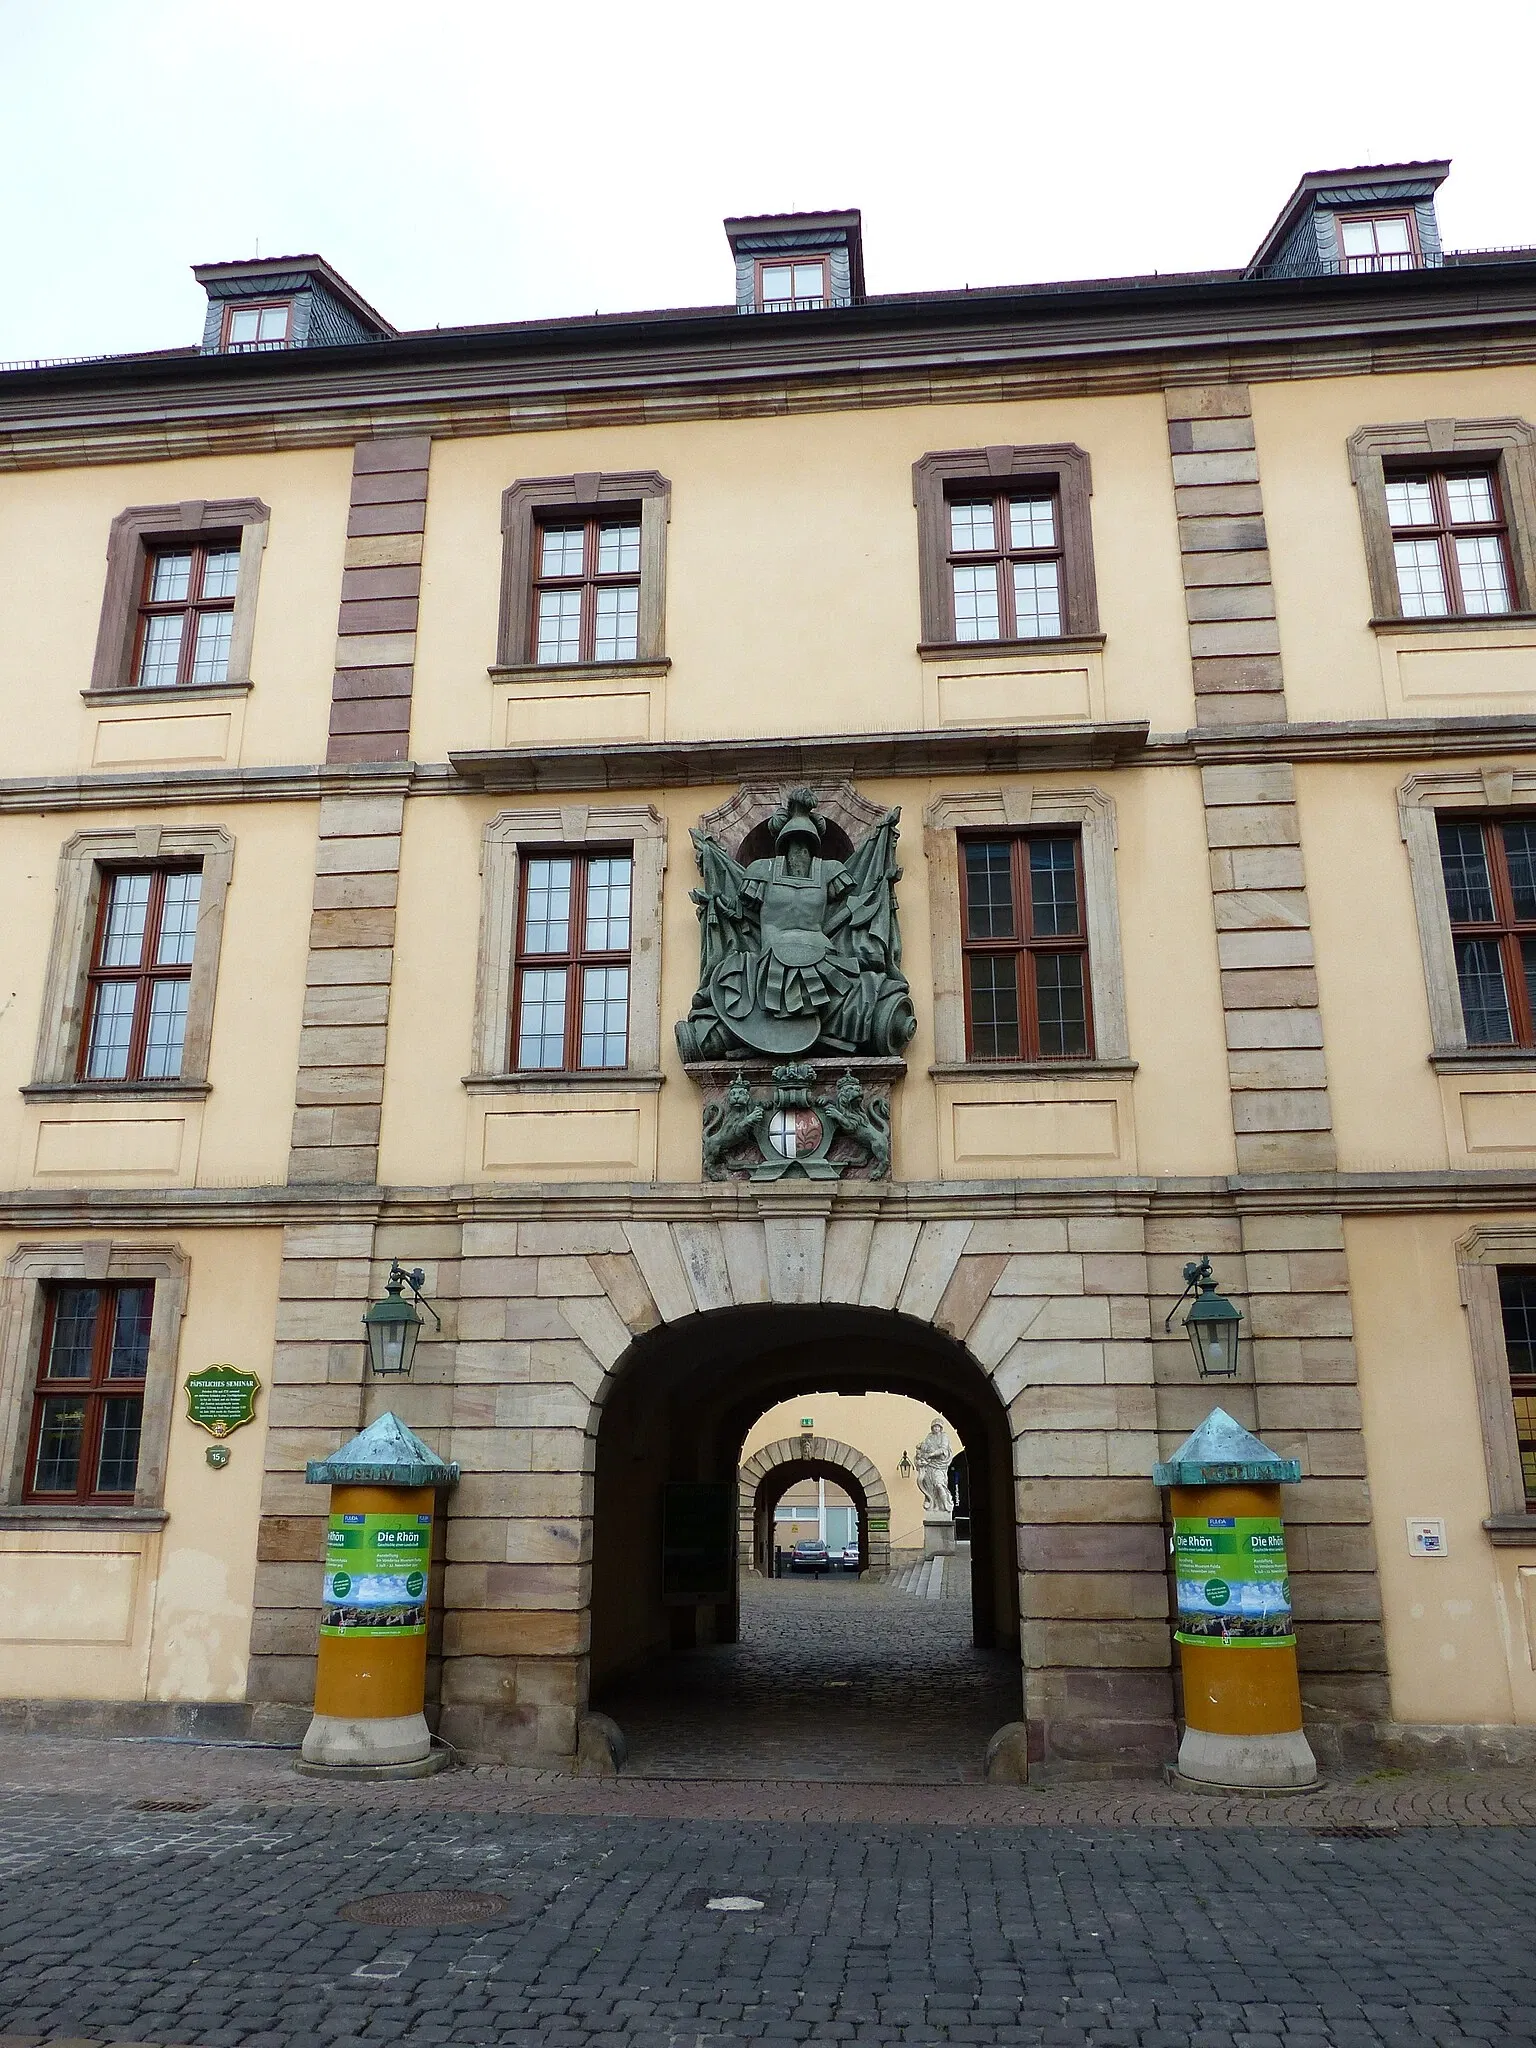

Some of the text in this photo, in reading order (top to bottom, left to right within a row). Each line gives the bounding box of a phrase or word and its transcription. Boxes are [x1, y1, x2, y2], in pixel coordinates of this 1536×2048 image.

[212, 1453, 220, 1461] 15
[377, 1532, 419, 1542] Die Rhön
[1188, 1535, 1213, 1547] Rhön
[1251, 1536, 1267, 1547] Die
